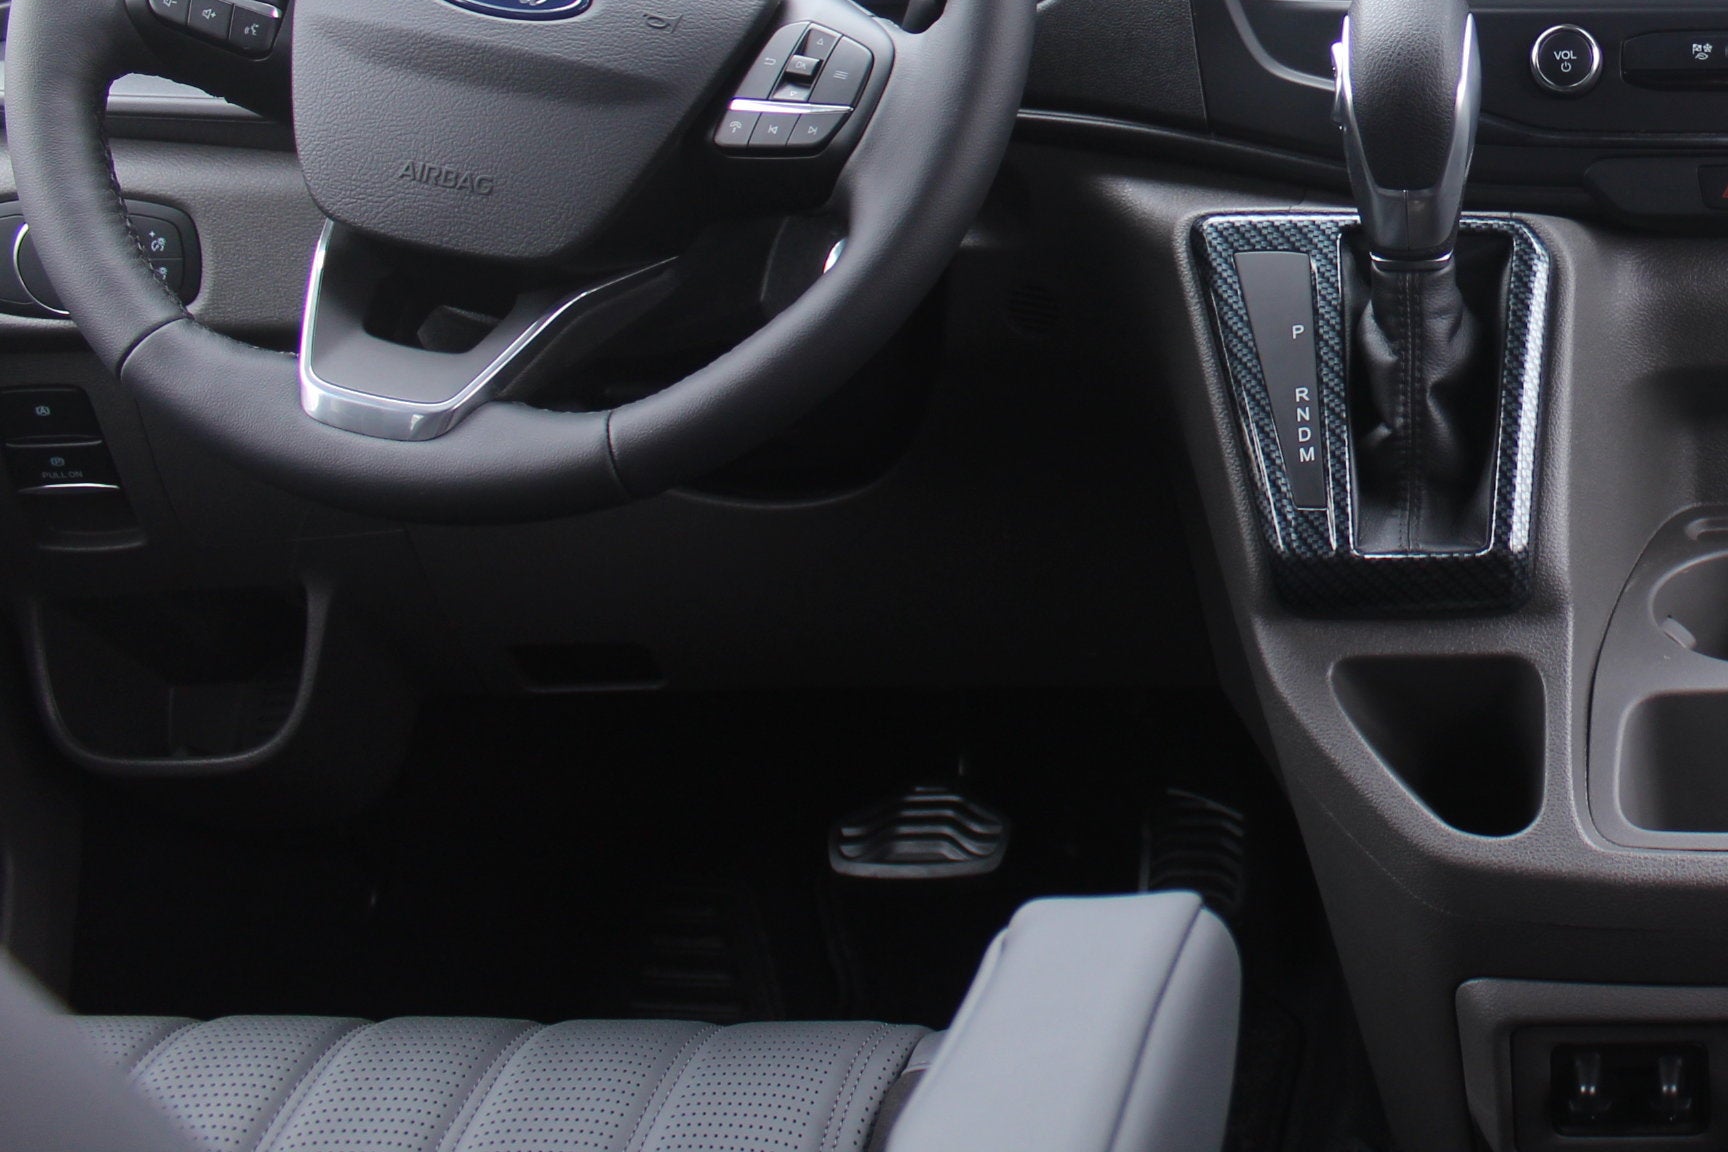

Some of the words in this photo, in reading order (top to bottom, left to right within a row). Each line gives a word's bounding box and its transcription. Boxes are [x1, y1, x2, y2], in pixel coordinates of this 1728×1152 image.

[1553, 50, 1577, 60] VOL
[399, 159, 494, 196] AIRBAG
[1291, 324, 1305, 340] P
[1295, 387, 1310, 402] R
[1296, 407, 1310, 422] N
[1298, 427, 1311, 442] D
[1299, 446, 1315, 462] M
[42, 471, 67, 479] PULL
[68, 470, 84, 478] ON
